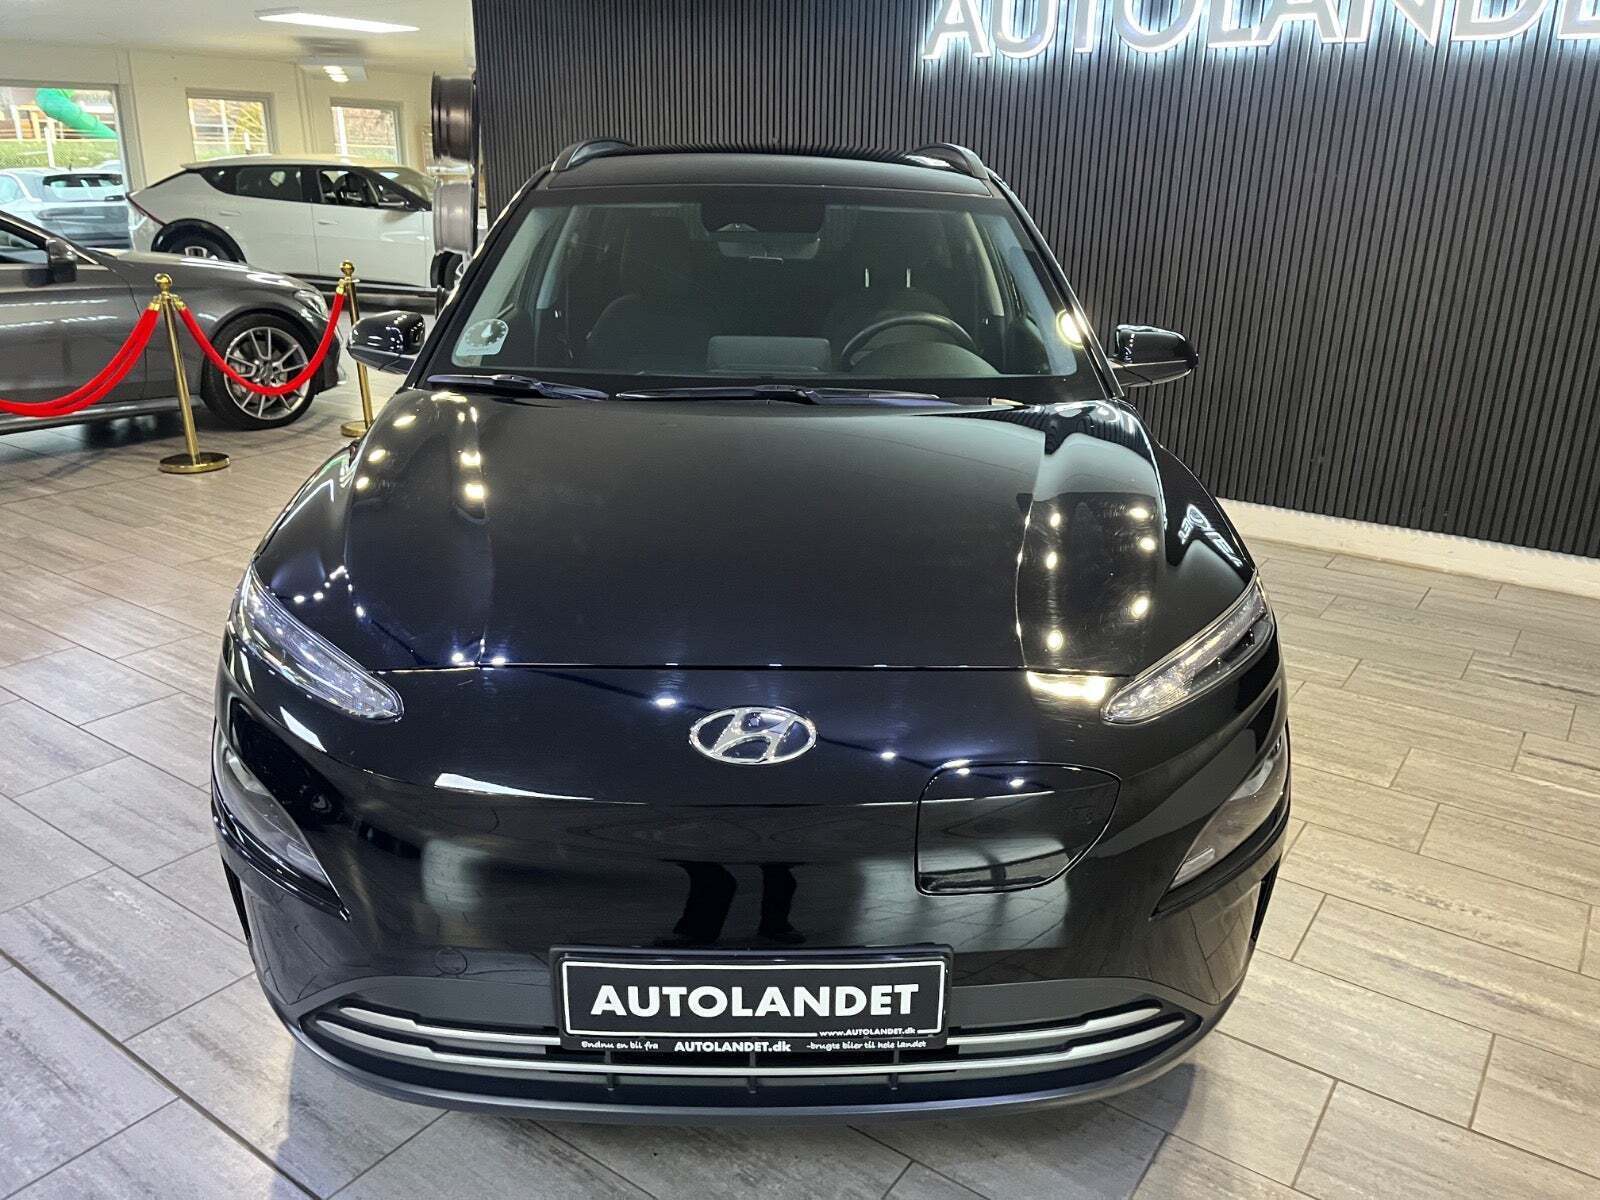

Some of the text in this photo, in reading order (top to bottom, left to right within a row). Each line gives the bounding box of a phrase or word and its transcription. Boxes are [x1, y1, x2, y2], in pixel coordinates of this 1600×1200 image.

[590, 983, 919, 1018] AUTOLANDET
[819, 1027, 916, 1037] www.AUTOLANDET.dk
[629, 1040, 643, 1049] bil
[644, 1040, 659, 1052] fra
[674, 1041, 792, 1053] AUTOLANDET.dk
[842, 1040, 863, 1050] biler
[864, 1040, 876, 1049] til
[877, 1040, 896, 1049] hele
[896, 1039, 927, 1049] landet
